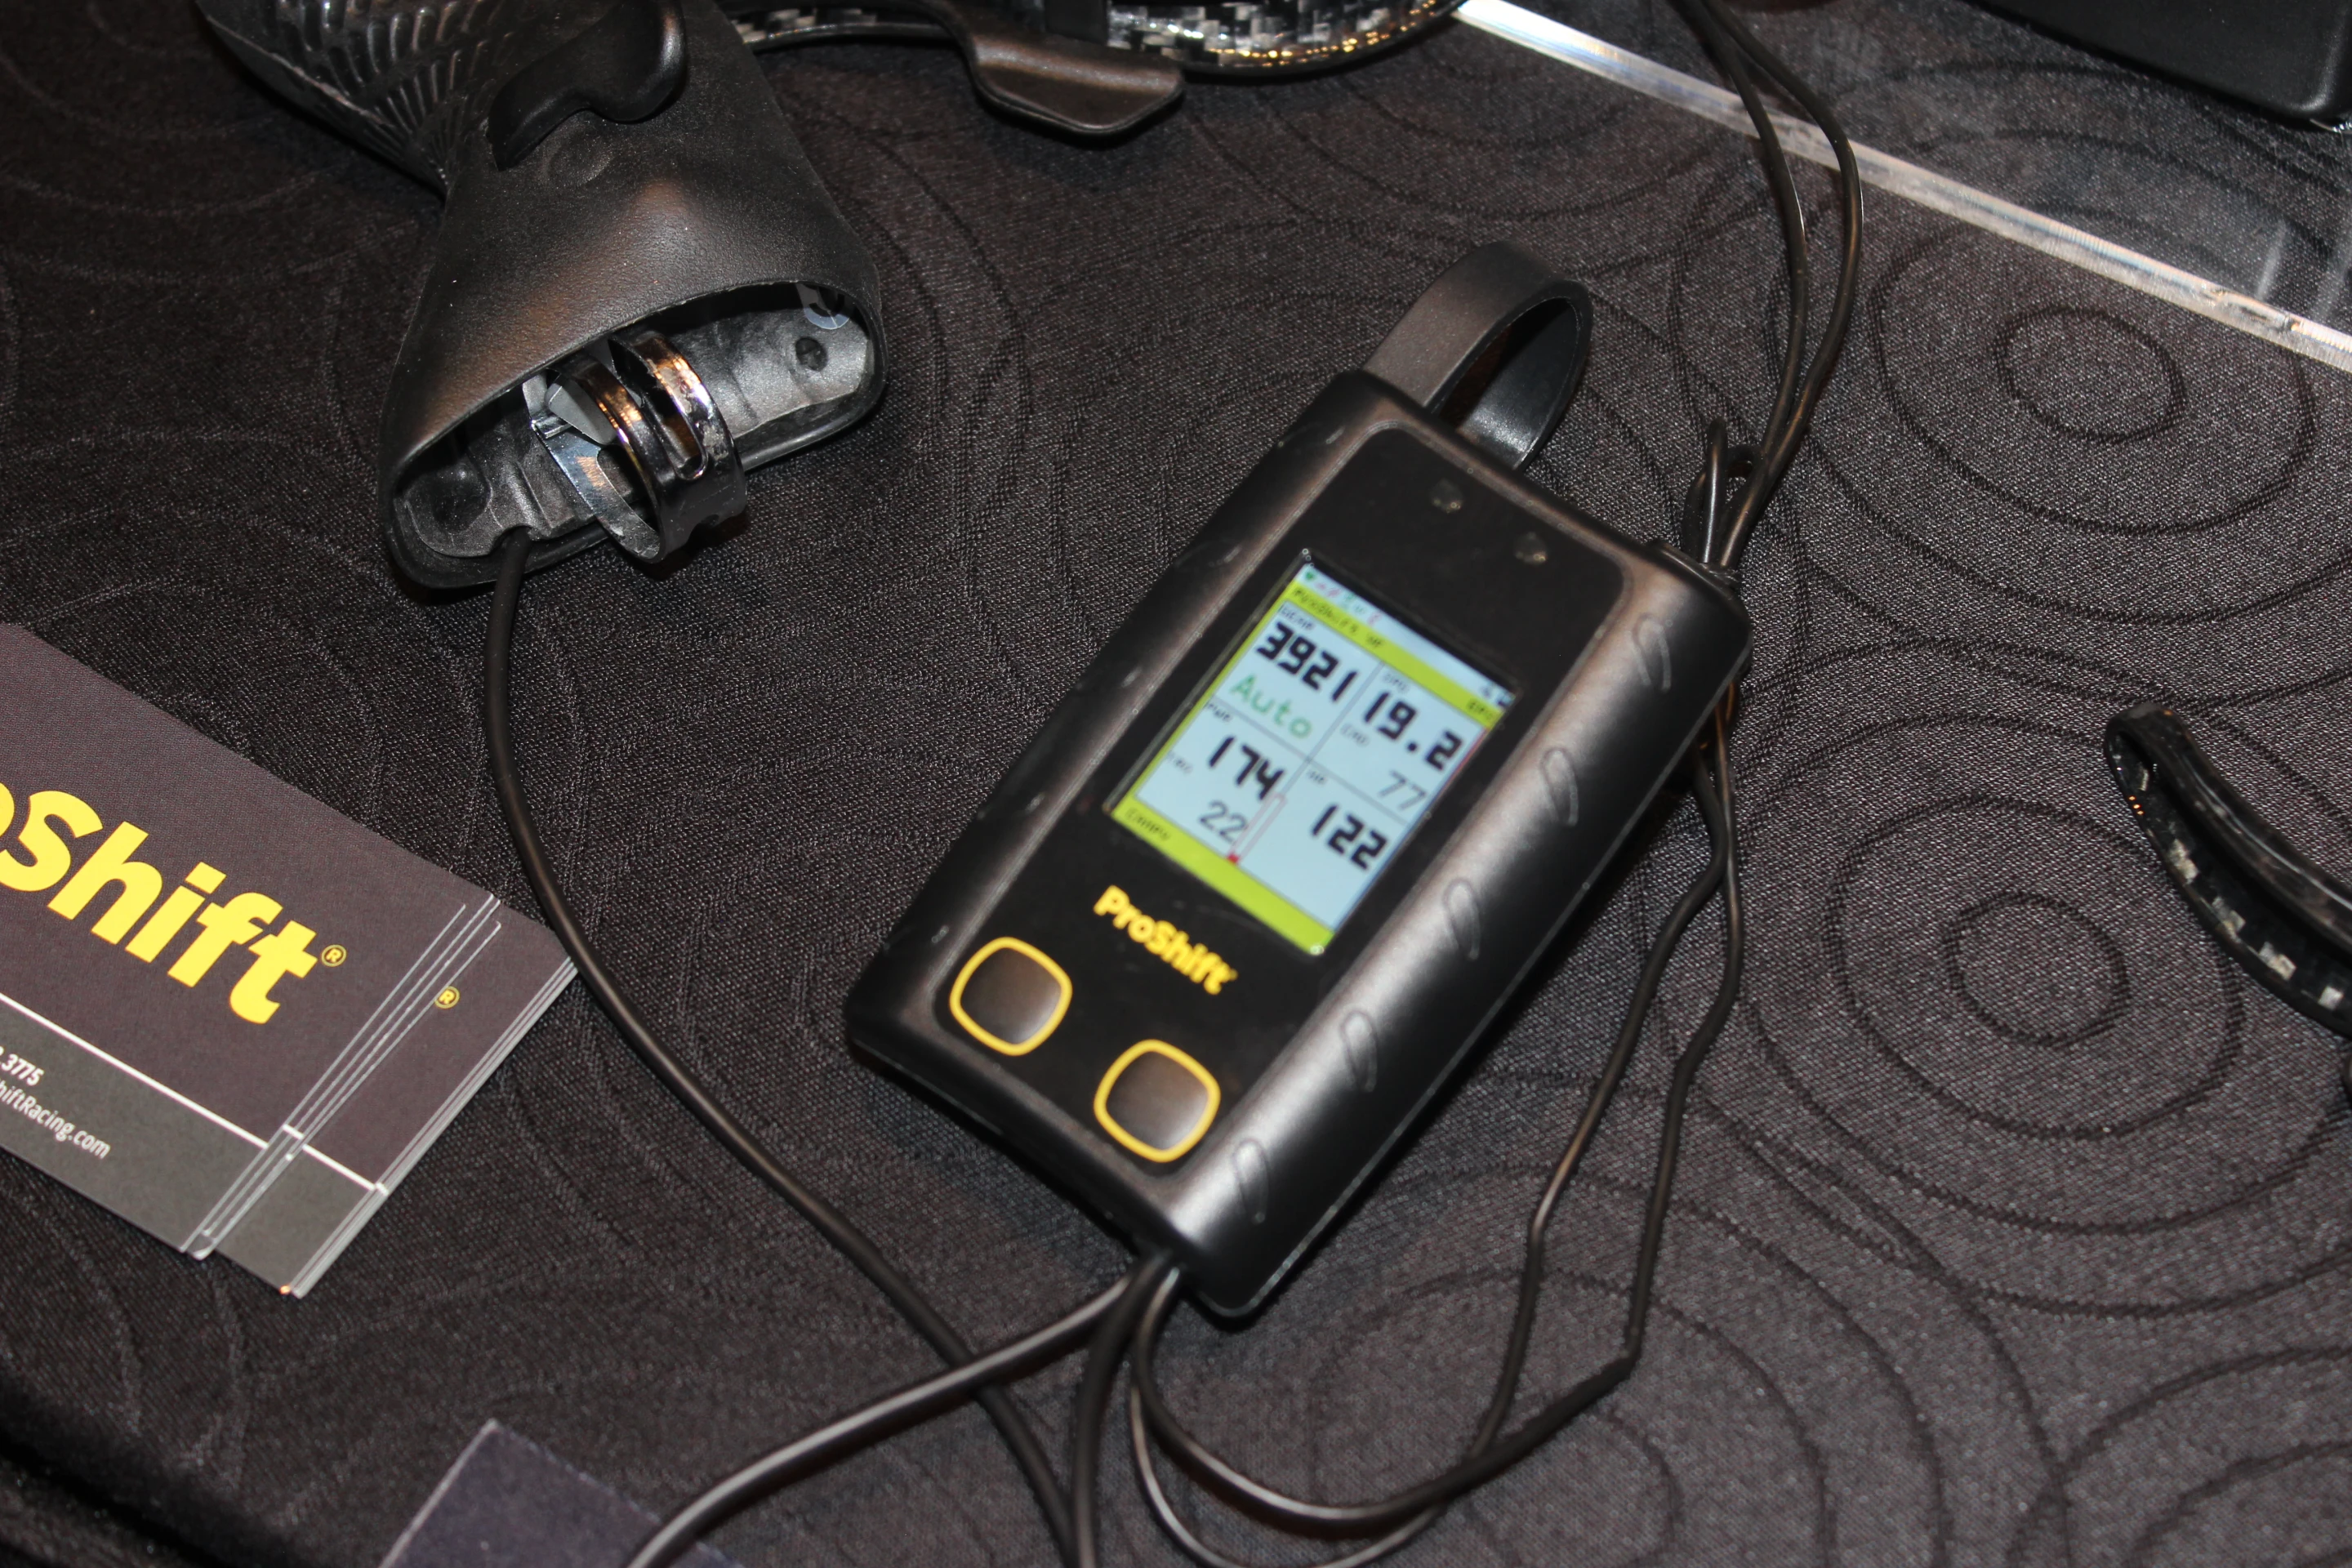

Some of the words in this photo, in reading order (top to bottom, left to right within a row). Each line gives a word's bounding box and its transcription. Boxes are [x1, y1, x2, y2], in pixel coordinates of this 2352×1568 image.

[1256, 621, 1358, 702] 3921
[1230, 675, 1312, 739] Auto
[1364, 692, 1463, 772] 19.2
[1209, 736, 1285, 801] 174
[1377, 769, 1428, 811] 77
[1199, 800, 1248, 844] 22
[1312, 804, 1388, 870] 122
[1093, 884, 1233, 996] ProShift
